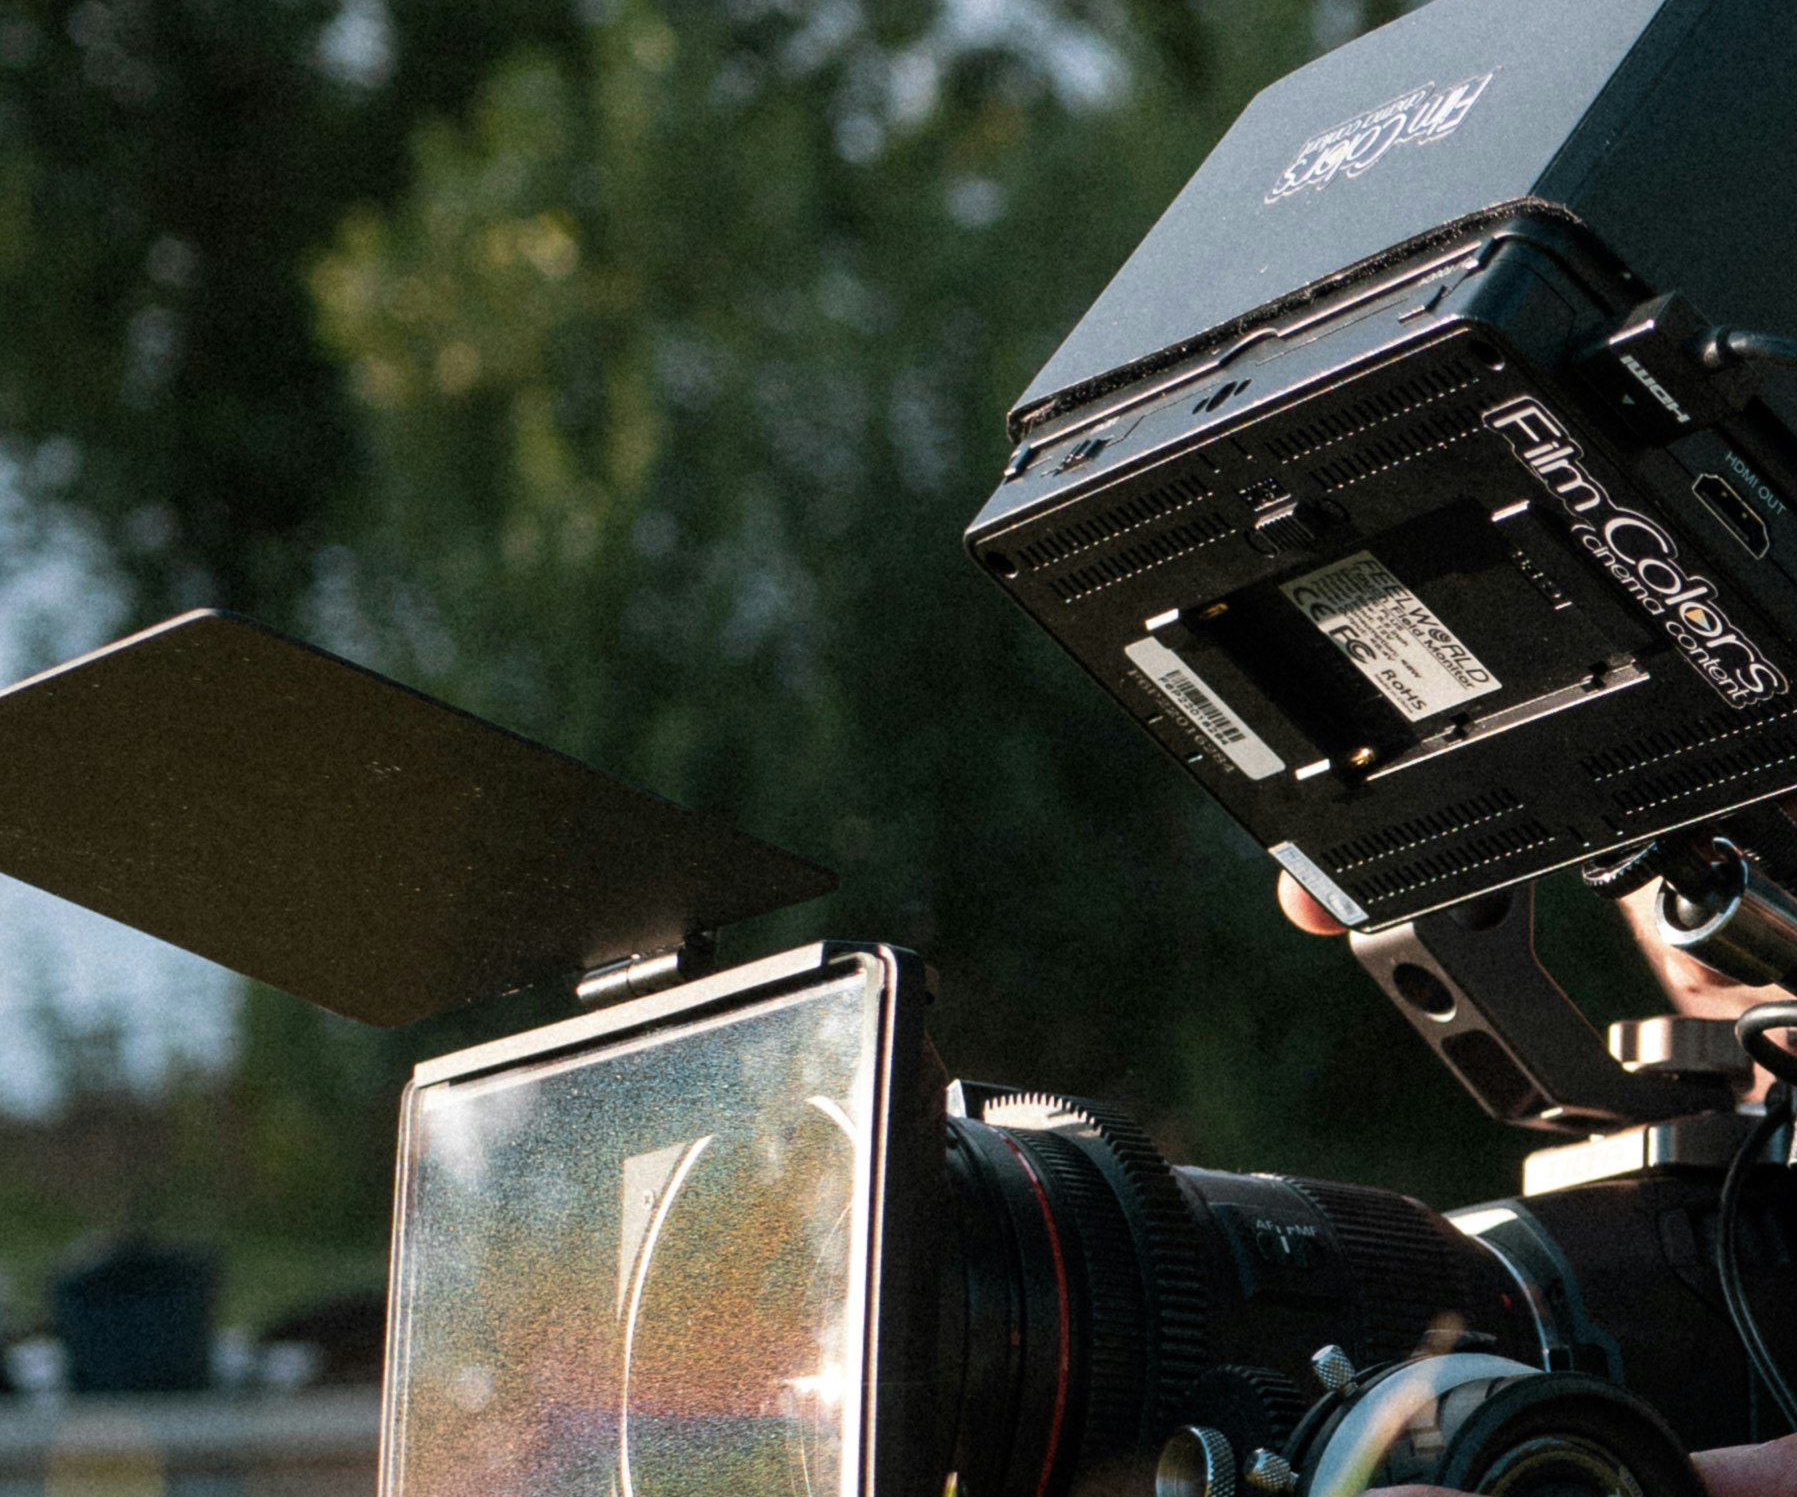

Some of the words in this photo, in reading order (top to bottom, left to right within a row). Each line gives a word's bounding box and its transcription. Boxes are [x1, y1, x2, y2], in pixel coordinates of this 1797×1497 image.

[1619, 355, 1691, 423] HDMI
[1724, 451, 1760, 490] HDMI
[1758, 485, 1787, 515] OUT
[1357, 559, 1491, 684] FEELWORLD
[1388, 605, 1426, 637] Field
[1421, 639, 1476, 689] Monitor
[1582, 534, 1665, 616] cinema
[1666, 620, 1750, 700] content
[1379, 668, 1428, 711] RoHS
